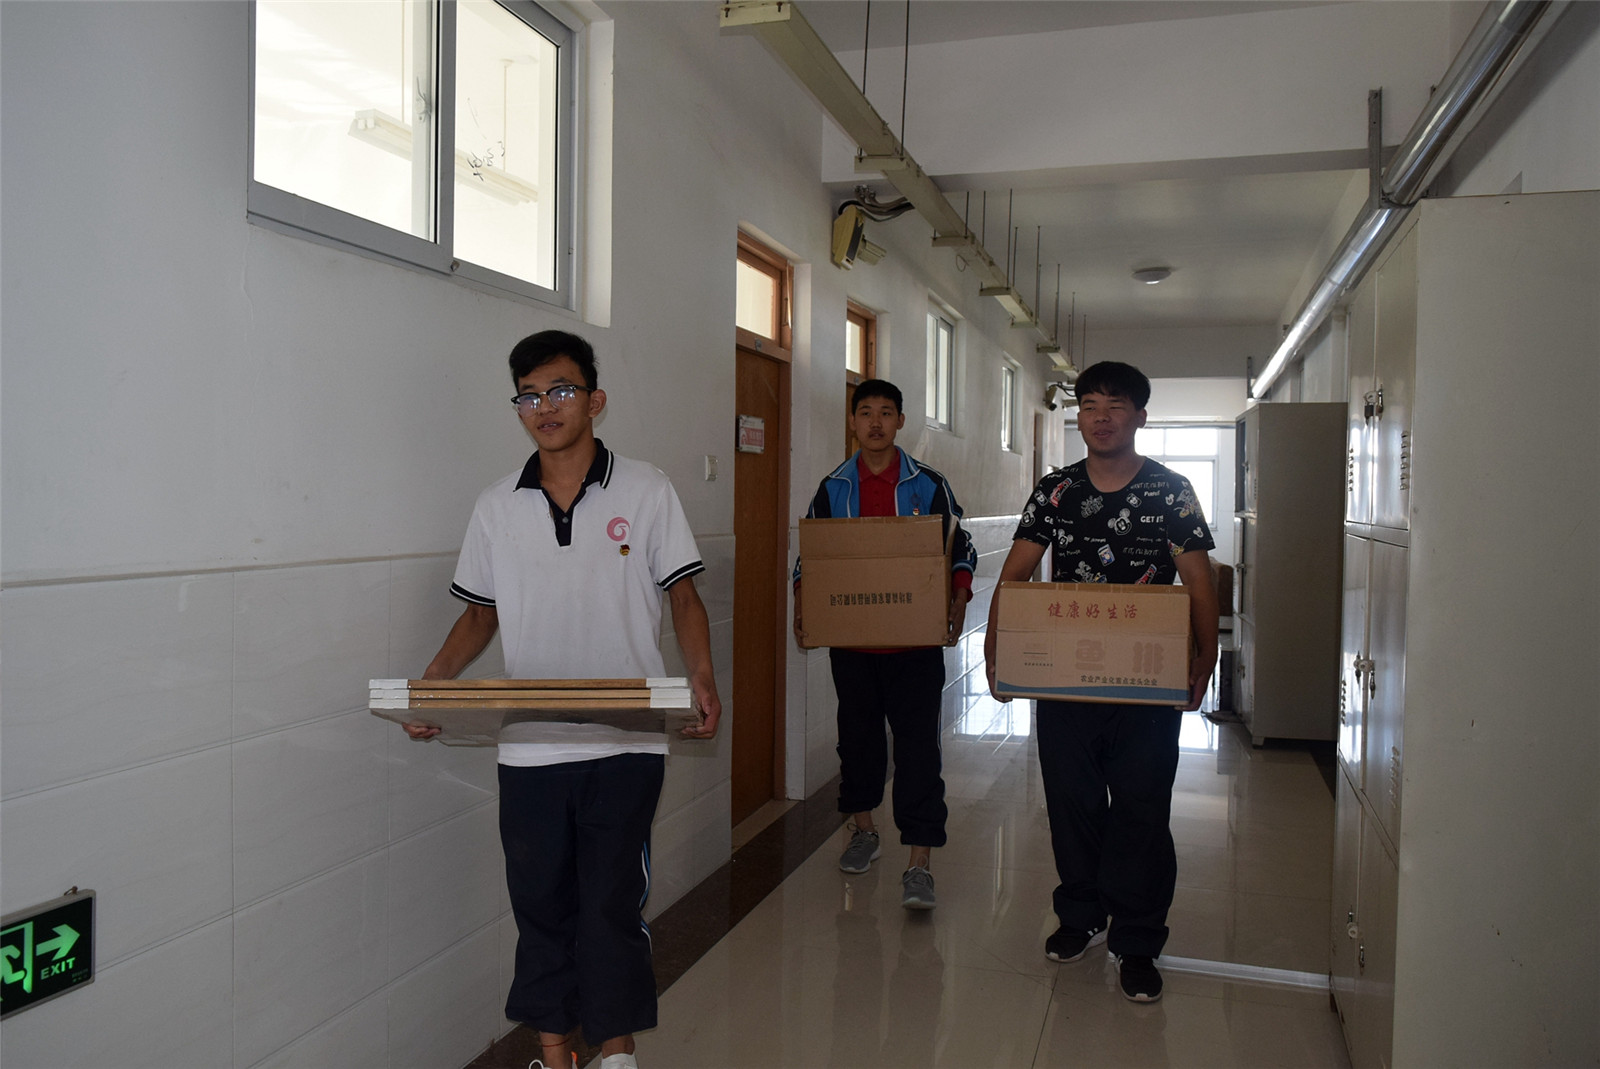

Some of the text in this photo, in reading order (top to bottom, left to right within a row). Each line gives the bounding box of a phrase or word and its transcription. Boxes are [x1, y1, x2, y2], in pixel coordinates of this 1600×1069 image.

[1140, 515, 1156, 523] GET
[1048, 600, 1138, 619] 健康好生活
[1080, 674, 1158, 686] 农业产业化重点龙头企业
[40, 957, 76, 980] EXIT
